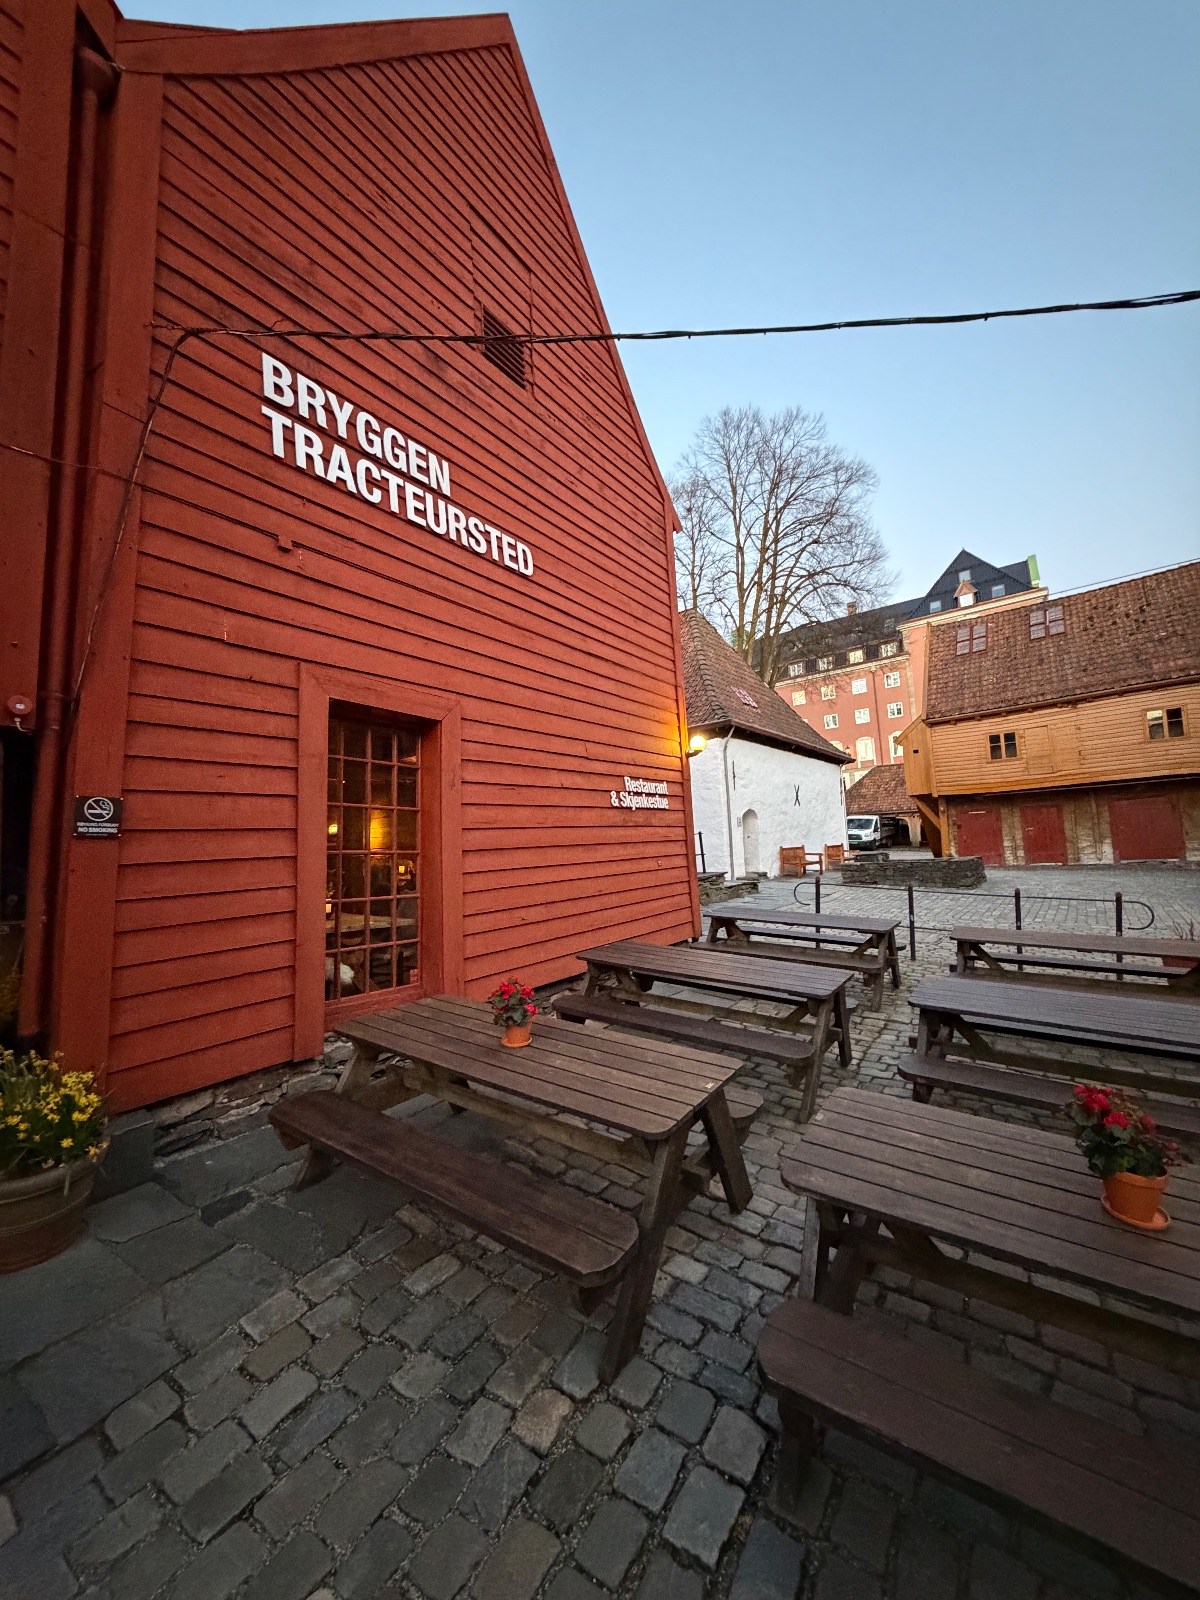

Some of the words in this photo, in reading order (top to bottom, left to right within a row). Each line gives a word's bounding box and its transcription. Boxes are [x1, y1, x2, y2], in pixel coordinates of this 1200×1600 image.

[261, 352, 451, 496] BRYGGEN
[261, 405, 534, 577] TRACTEURSTED
[610, 790, 619, 807] &
[620, 792, 669, 811] Skjenkestue
[624, 776, 668, 795] Restaurant
